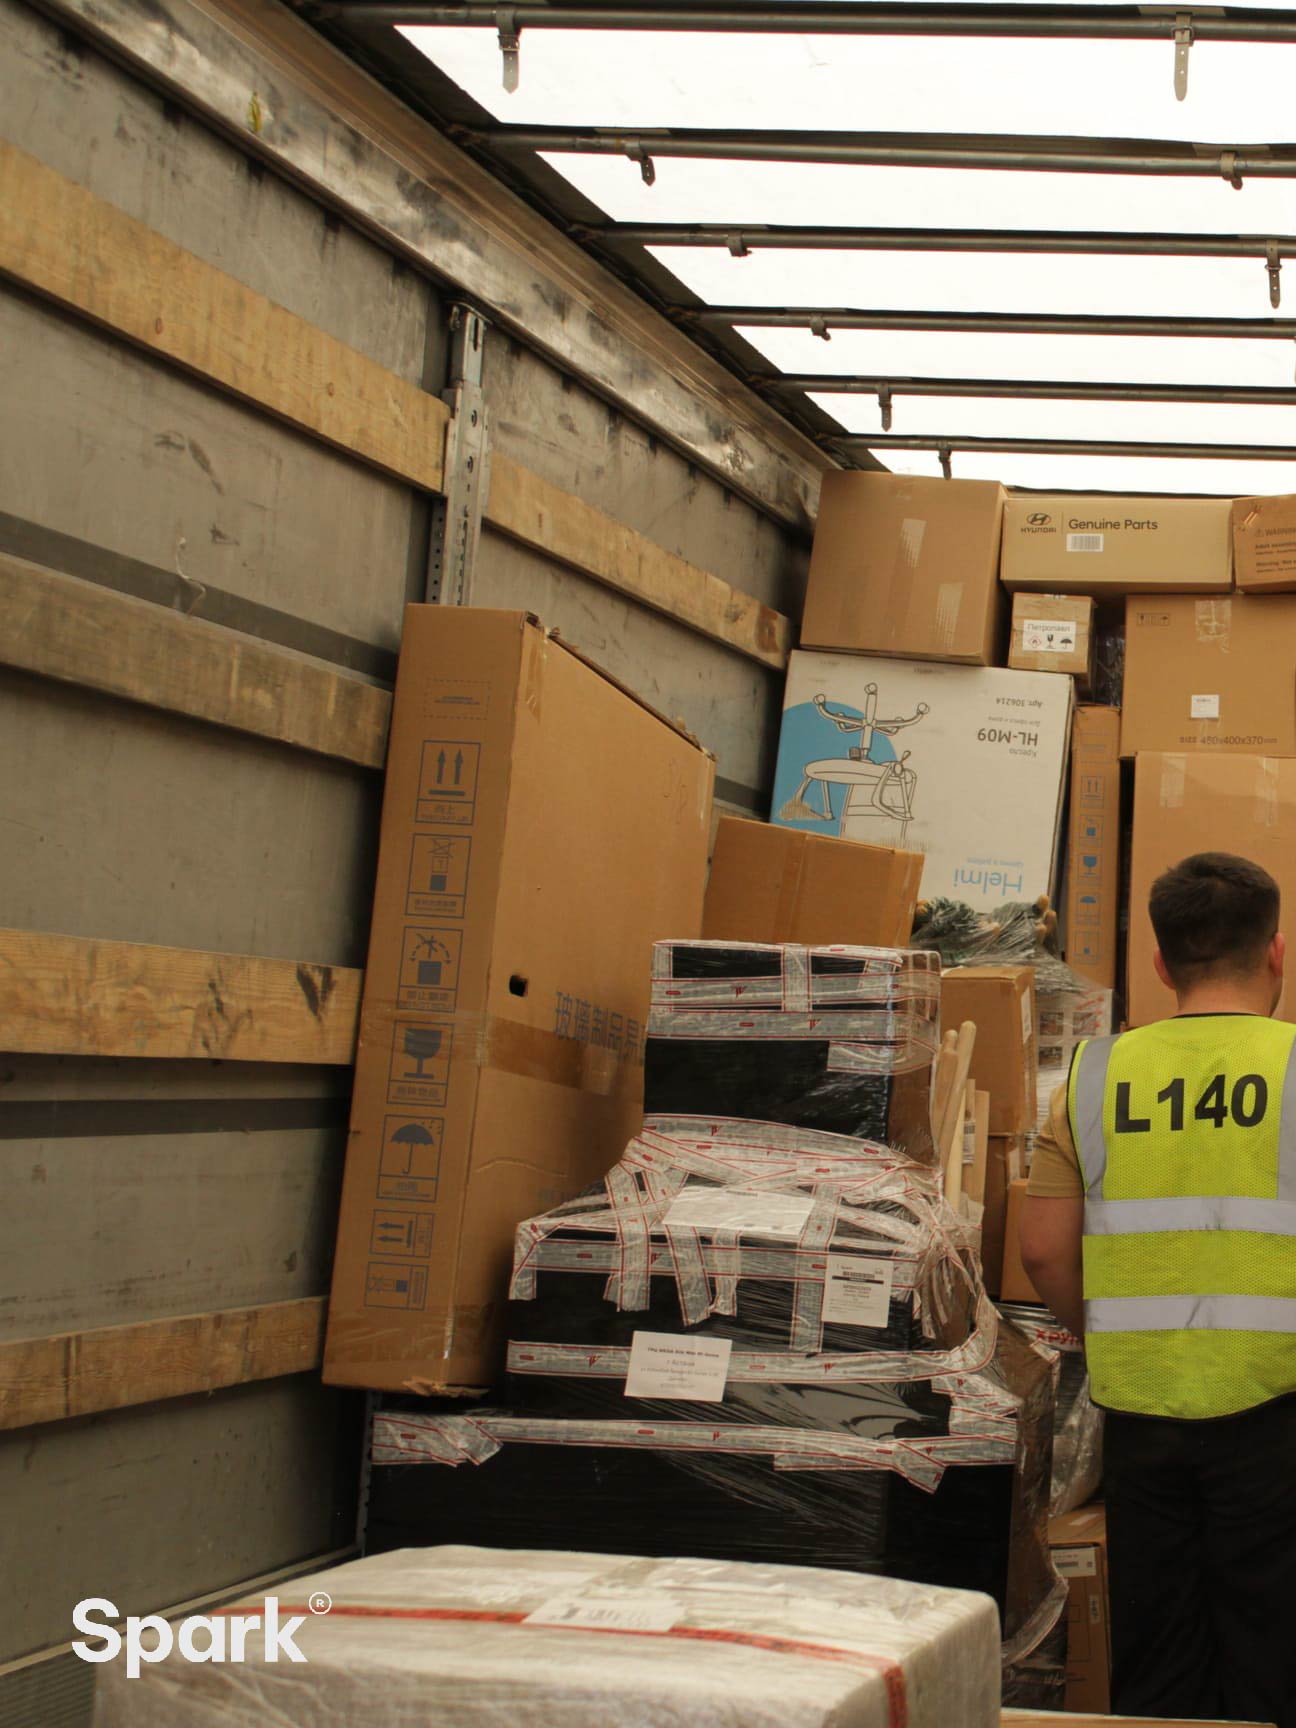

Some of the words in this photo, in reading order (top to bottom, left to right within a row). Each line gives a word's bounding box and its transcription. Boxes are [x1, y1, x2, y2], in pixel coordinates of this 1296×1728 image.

[1068, 518, 1121, 531] Genuine
[1124, 518, 1159, 531] Parts
[976, 728, 1039, 747] HL-M09
[953, 868, 1023, 897] Helmi
[1114, 1073, 1269, 1135] L140
